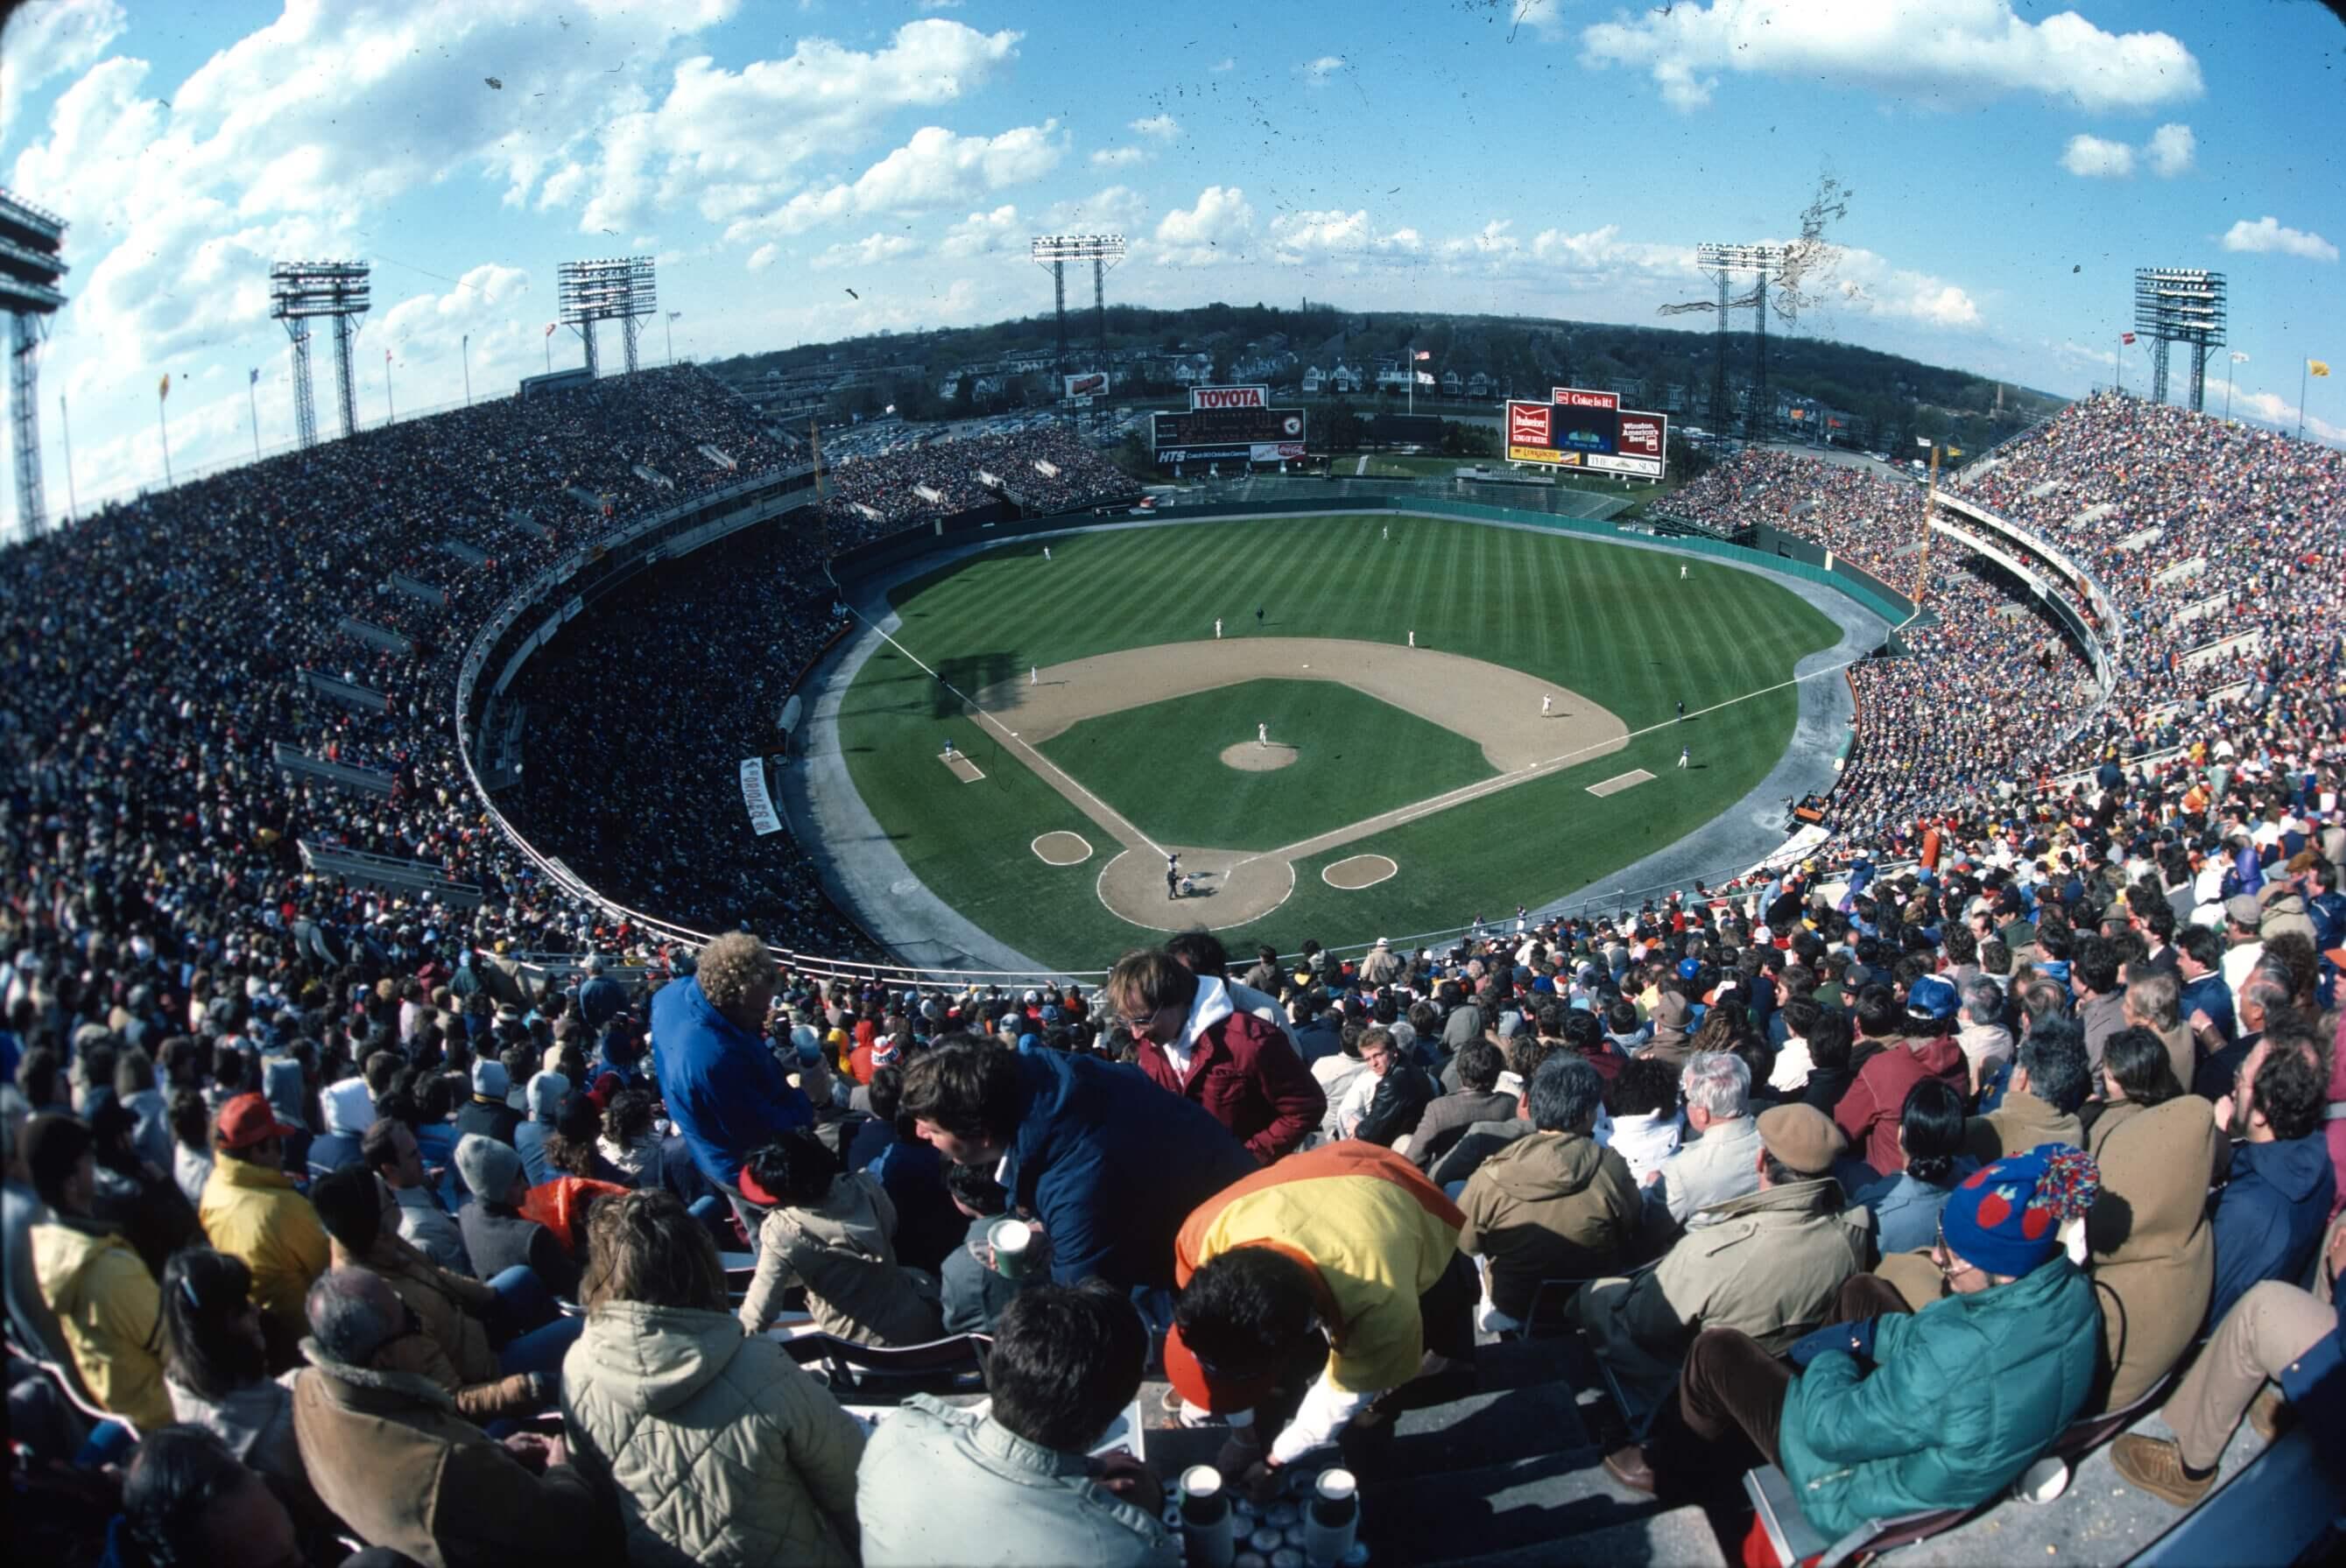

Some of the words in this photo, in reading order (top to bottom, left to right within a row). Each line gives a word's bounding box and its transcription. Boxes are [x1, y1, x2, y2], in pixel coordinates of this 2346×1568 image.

[1197, 390, 1261, 407] TOYOTA
[1572, 394, 1593, 406] Coke
[1516, 415, 1546, 428] Budweiser
[1159, 450, 1186, 462] HTS
[1589, 456, 1607, 467] THE
[1638, 461, 1658, 473] SUN
